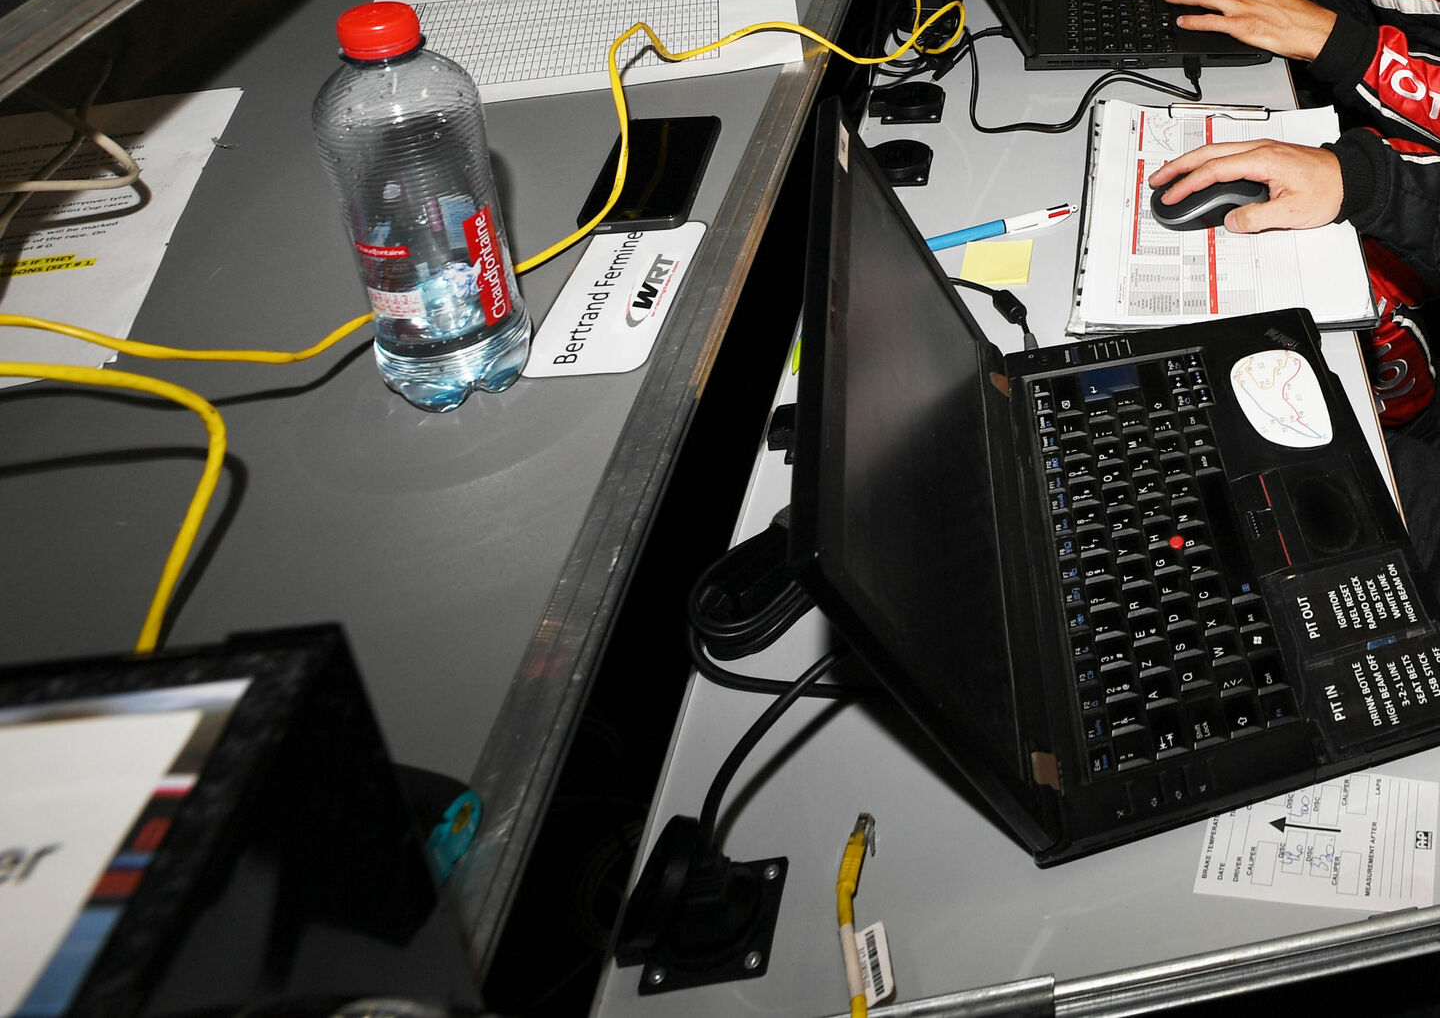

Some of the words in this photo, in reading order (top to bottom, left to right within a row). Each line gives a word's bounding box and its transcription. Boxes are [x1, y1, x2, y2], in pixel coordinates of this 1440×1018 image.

[45, 254, 76, 264] THEY
[632, 253, 675, 312] WRT
[553, 288, 611, 366] Bertrand
[1387, 563, 1398, 576] ON
[1351, 576, 1366, 600] CHECK
[1366, 579, 1381, 602] STICK
[1377, 573, 1391, 591] LINE
[1394, 577, 1409, 602] BEAM
[1339, 584, 1355, 607] RESET
[1385, 592, 1401, 619] WHITE
[1297, 596, 1314, 620] OUT
[1328, 590, 1347, 629] IGNITION
[1350, 608, 1362, 629] FUEL
[1361, 601, 1377, 630] RADIO
[1373, 601, 1387, 619] USB
[1404, 602, 1418, 623] HIGH
[1305, 620, 1321, 639] PIT
[1366, 654, 1381, 672] OFF
[1386, 661, 1401, 681] LINE
[1401, 654, 1418, 681] BELTS
[1417, 653, 1433, 677] STICK
[1352, 662, 1371, 697] BOTTLE
[1375, 672, 1391, 702] BEAM
[1429, 678, 1440, 697] USB
[1325, 685, 1337, 700] IN
[1395, 681, 1410, 707] 3-2-1
[1414, 681, 1427, 705] SEAT
[1330, 701, 1346, 721] PIT
[1365, 697, 1382, 727] DRINK
[1384, 702, 1399, 725] HIGH
[1286, 793, 1294, 809] DISC
[1313, 796, 1321, 812] DISC
[1341, 778, 1350, 806] CALIPER
[1201, 854, 1211, 879] BRAKE
[1217, 862, 1225, 880] DATE
[1233, 856, 1243, 882] DRIVER
[1246, 846, 1257, 876] CALIPER
[1331, 856, 1341, 886] CALIPER
[1365, 845, 1375, 897] MEASUREMENT
